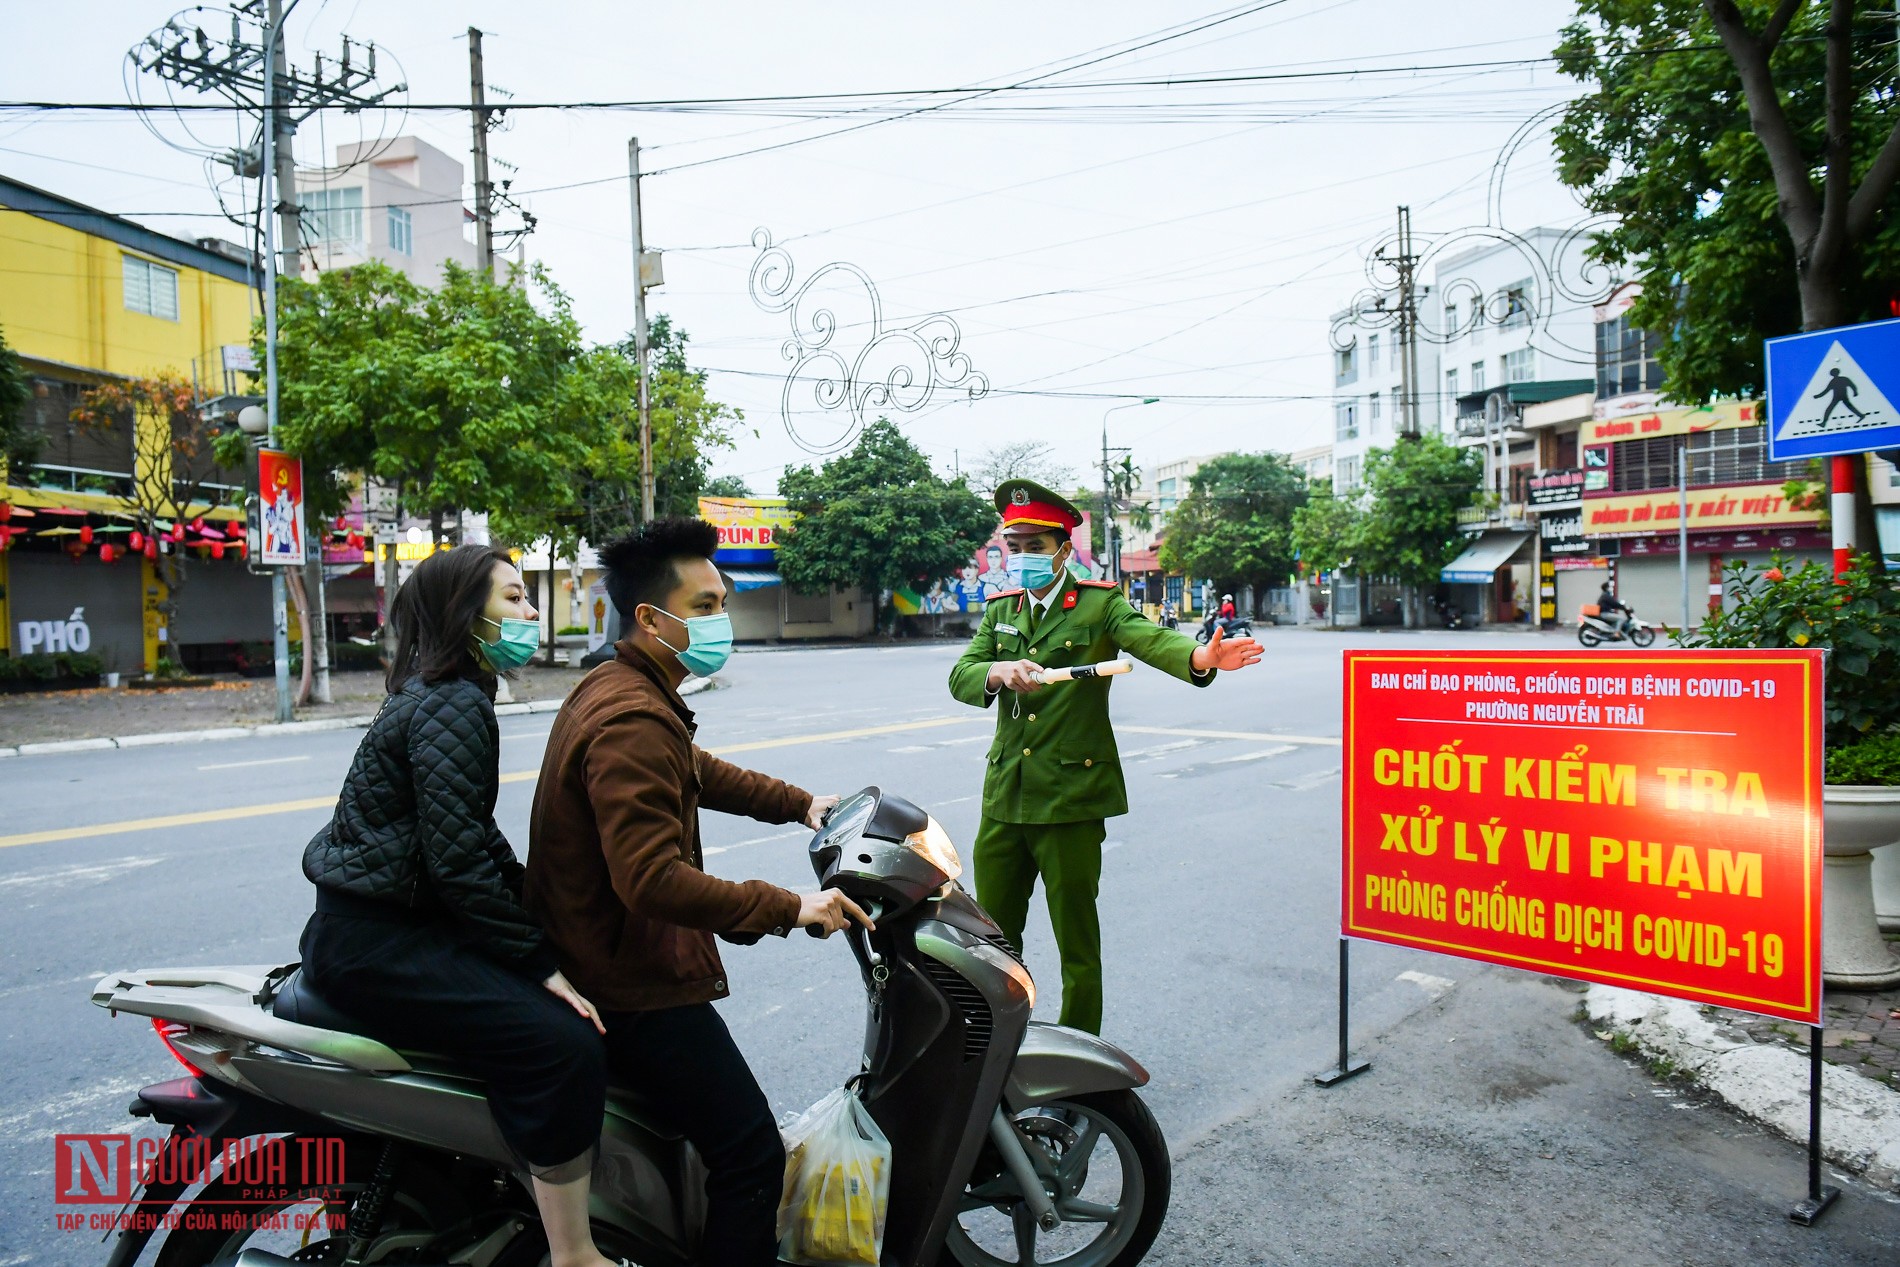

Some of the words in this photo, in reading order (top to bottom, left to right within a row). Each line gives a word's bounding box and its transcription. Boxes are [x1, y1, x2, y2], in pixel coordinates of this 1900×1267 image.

[1698, 494, 1738, 518] MẮT
[1741, 494, 1784, 517] VIỆT
[717, 522, 753, 545] BÚN
[18, 606, 91, 654] PHỐ
[1371, 673, 1400, 690] BAN
[1403, 669, 1427, 691] CHỈ
[1430, 675, 1460, 693] ĐẠO
[1464, 671, 1520, 696] PHÒNG,
[1525, 669, 1581, 695] CHỐNG
[1586, 676, 1626, 700] DỊCH
[1632, 674, 1681, 700] BỆNH
[1686, 677, 1776, 699] COVID-19
[1466, 698, 1529, 721] PHƯỜNG
[1533, 699, 1600, 724] NGUYỄN
[1605, 702, 1645, 725] TRÃI
[1373, 739, 1488, 793] CHỐT
[1504, 744, 1636, 807] KIỂM
[1657, 766, 1771, 818] TRA
[1380, 805, 1444, 856] XỬ
[1454, 817, 1507, 864] LÝ
[1522, 829, 1570, 874] VI
[1590, 836, 1763, 900] PHẠM
[1365, 869, 1447, 922] PHÒNG
[1455, 879, 1545, 939] CHỐNG
[1554, 902, 1623, 954] DỊCH
[1633, 913, 1783, 978] COVID-19
